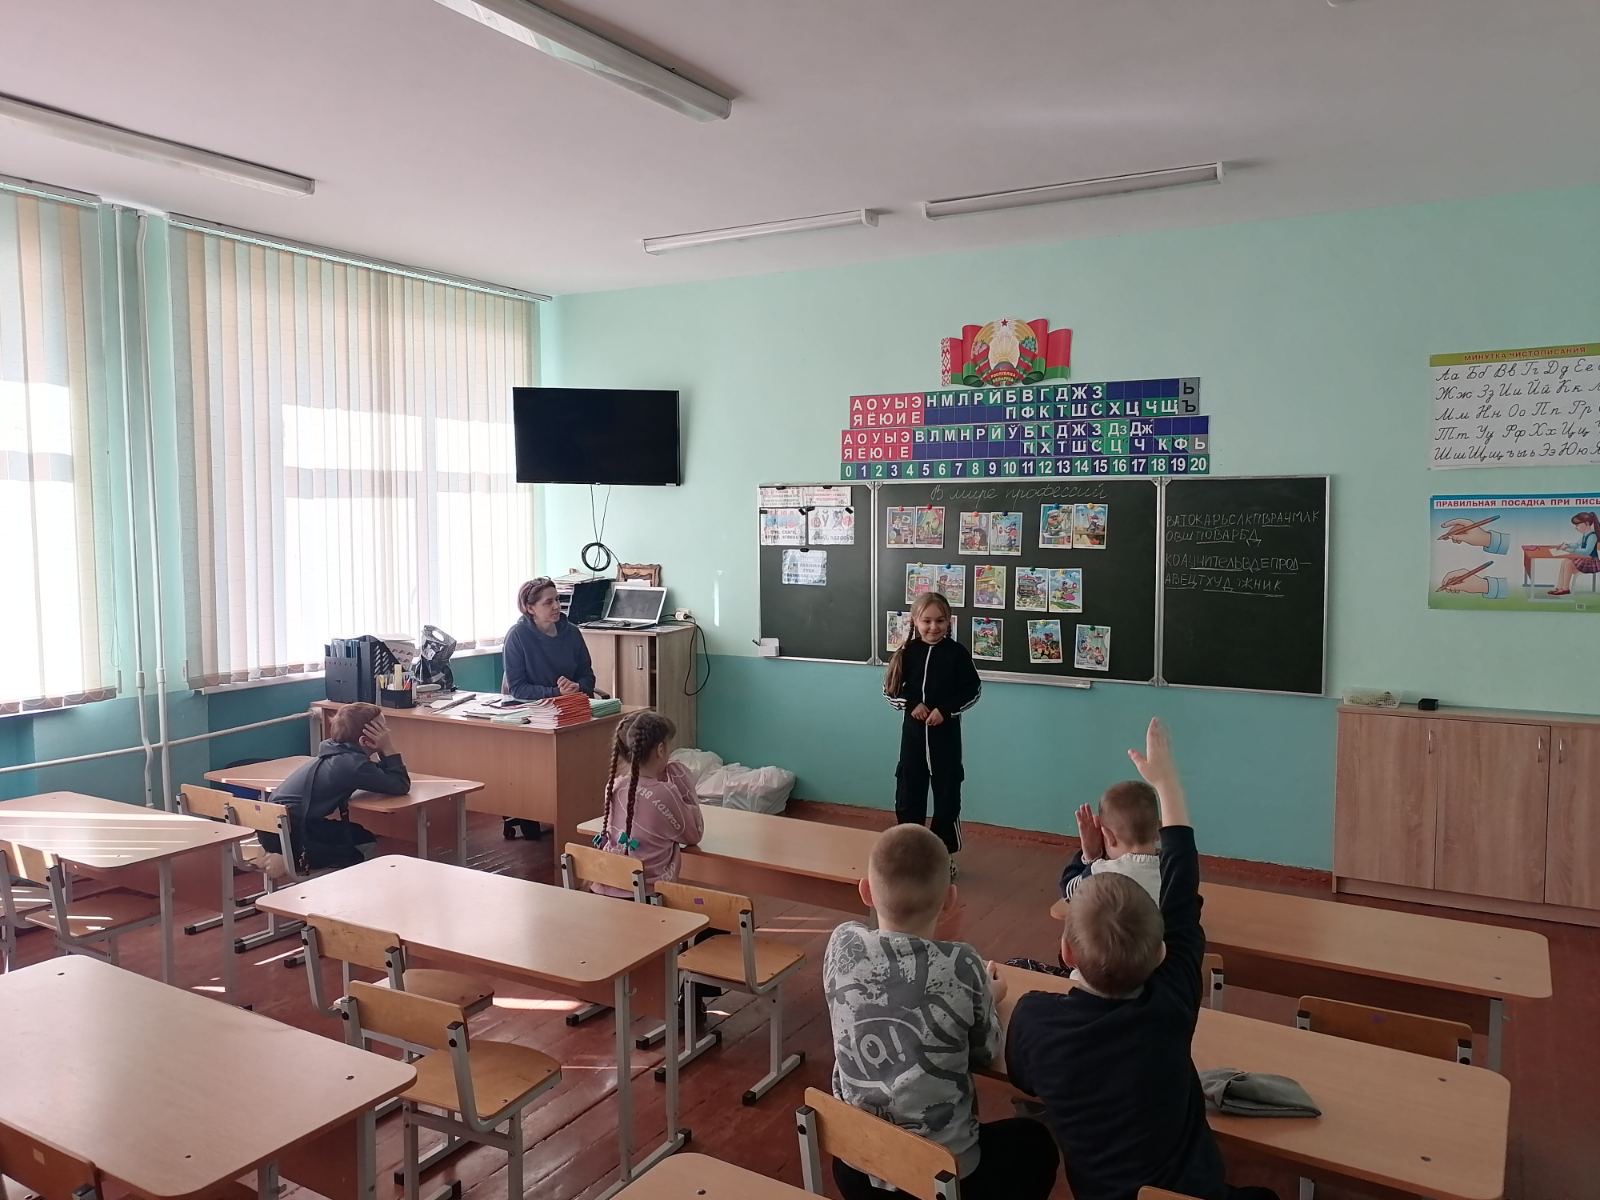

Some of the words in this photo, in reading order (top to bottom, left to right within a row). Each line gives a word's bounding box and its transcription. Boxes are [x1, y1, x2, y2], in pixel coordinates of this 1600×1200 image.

[1465, 352, 1506, 361] МИНУТКА
[1509, 347, 1586, 359] ЧИСТОПИСАНИЯ
[1436, 368, 1459, 381] Аа
[1467, 365, 1492, 379] Бб
[1494, 363, 1517, 377] Вв
[1521, 361, 1539, 376] Гг
[1544, 361, 1569, 379] Дд
[1574, 359, 1593, 372] Ее
[853, 400, 862, 411] А
[867, 399, 877, 410] О
[882, 398, 891, 409] У
[895, 397, 907, 409] Ы
[912, 396, 921, 408] Э
[927, 395, 936, 407] Н
[942, 394, 952, 406] М
[958, 394, 968, 406] Л
[974, 393, 983, 405] Р
[990, 389, 1000, 404] Й
[1006, 391, 1016, 402] Б
[1022, 390, 1033, 401] В
[1041, 389, 1049, 401] Г
[1056, 388, 1068, 401] Д
[1072, 387, 1087, 399] Ж
[1093, 386, 1102, 398] З
[1184, 382, 1194, 394] Ь
[1436, 386, 1472, 400] Жж
[1477, 384, 1494, 403] Зз
[1500, 383, 1522, 396] Ии
[1528, 379, 1550, 395] Йй
[1556, 380, 1582, 394] Кк
[854, 415, 862, 426] Я
[868, 412, 876, 425] Ё
[880, 413, 893, 424] Ю
[897, 412, 905, 424] И
[912, 412, 920, 423] Е
[1006, 407, 1016, 419] П
[1022, 407, 1034, 418] Ф
[1040, 406, 1049, 418] К
[1057, 405, 1067, 417] Т
[1072, 404, 1087, 416] Ш
[1091, 403, 1102, 416] С
[1109, 402, 1120, 415] Х
[1126, 402, 1139, 416] Ц
[1146, 401, 1156, 413] Ч
[1162, 400, 1178, 414] Щ
[1182, 400, 1196, 412] Ъ
[1435, 408, 1469, 420] Мм
[1476, 404, 1501, 419] Нн
[1509, 404, 1526, 417] Оо
[1532, 402, 1561, 416] Пп
[1569, 401, 1592, 419] Рр
[844, 434, 852, 444] А
[858, 433, 867, 444] О
[873, 433, 880, 443] У
[885, 432, 896, 443] Ы
[901, 431, 909, 442] Э
[916, 431, 924, 442] В
[930, 431, 938, 441] Л
[945, 430, 955, 441] М
[961, 429, 969, 440] Н
[977, 429, 985, 440] Р
[992, 425, 1000, 439] Й
[1008, 425, 1018, 439] Ў
[1025, 426, 1034, 437] Б
[1042, 426, 1050, 437] Г
[1057, 425, 1067, 439] Д
[1072, 424, 1086, 436] Ж
[1092, 424, 1101, 435] З
[1108, 423, 1127, 436] Дз
[1130, 422, 1153, 436] Дж
[1435, 427, 1469, 440] Тт
[1476, 425, 1494, 445] Уу
[1502, 424, 1525, 443] Фф
[1529, 423, 1556, 436] Хх
[1561, 422, 1590, 437] Цц
[844, 449, 852, 459] Я
[871, 448, 882, 458] Ю
[901, 447, 908, 457] Е
[1024, 442, 1033, 453] П
[1041, 442, 1050, 453] Х
[1058, 441, 1067, 453] Т
[1072, 441, 1086, 452] Ш
[1092, 440, 1101, 451] С
[1111, 440, 1121, 453] Ц
[1135, 439, 1145, 451] Ч
[1159, 439, 1168, 450] К
[1174, 438, 1187, 450] Ф
[1195, 438, 1205, 449] Ь
[1434, 447, 1466, 460] Шш
[1469, 446, 1503, 461] Щщ
[1539, 443, 1556, 456] Ээ
[1559, 442, 1588, 456] Юю
[846, 466, 851, 477] 0
[861, 465, 866, 477] 1
[876, 465, 882, 476] 2
[891, 465, 897, 476] 3
[907, 464, 913, 476] 4
[923, 464, 929, 475] 5
[939, 464, 945, 475] 6
[955, 463, 962, 475] 7
[972, 463, 979, 475] 8
[989, 462, 996, 474] 9
[1004, 462, 1016, 474] 10
[1022, 461, 1033, 473] 11
[1039, 461, 1052, 473] 12
[1057, 461, 1070, 473] 13
[1075, 460, 1089, 472] 14
[1094, 460, 1107, 472] 15
[1113, 459, 1126, 472] 16
[1132, 459, 1146, 471] 17
[1151, 458, 1165, 471] 18
[1171, 458, 1185, 471] 19
[1190, 458, 1206, 471] 20
[930, 485, 944, 500] В
[949, 488, 998, 508] мире
[1005, 485, 1108, 510] профессий
[653, 800, 680, 830] COMEDY
